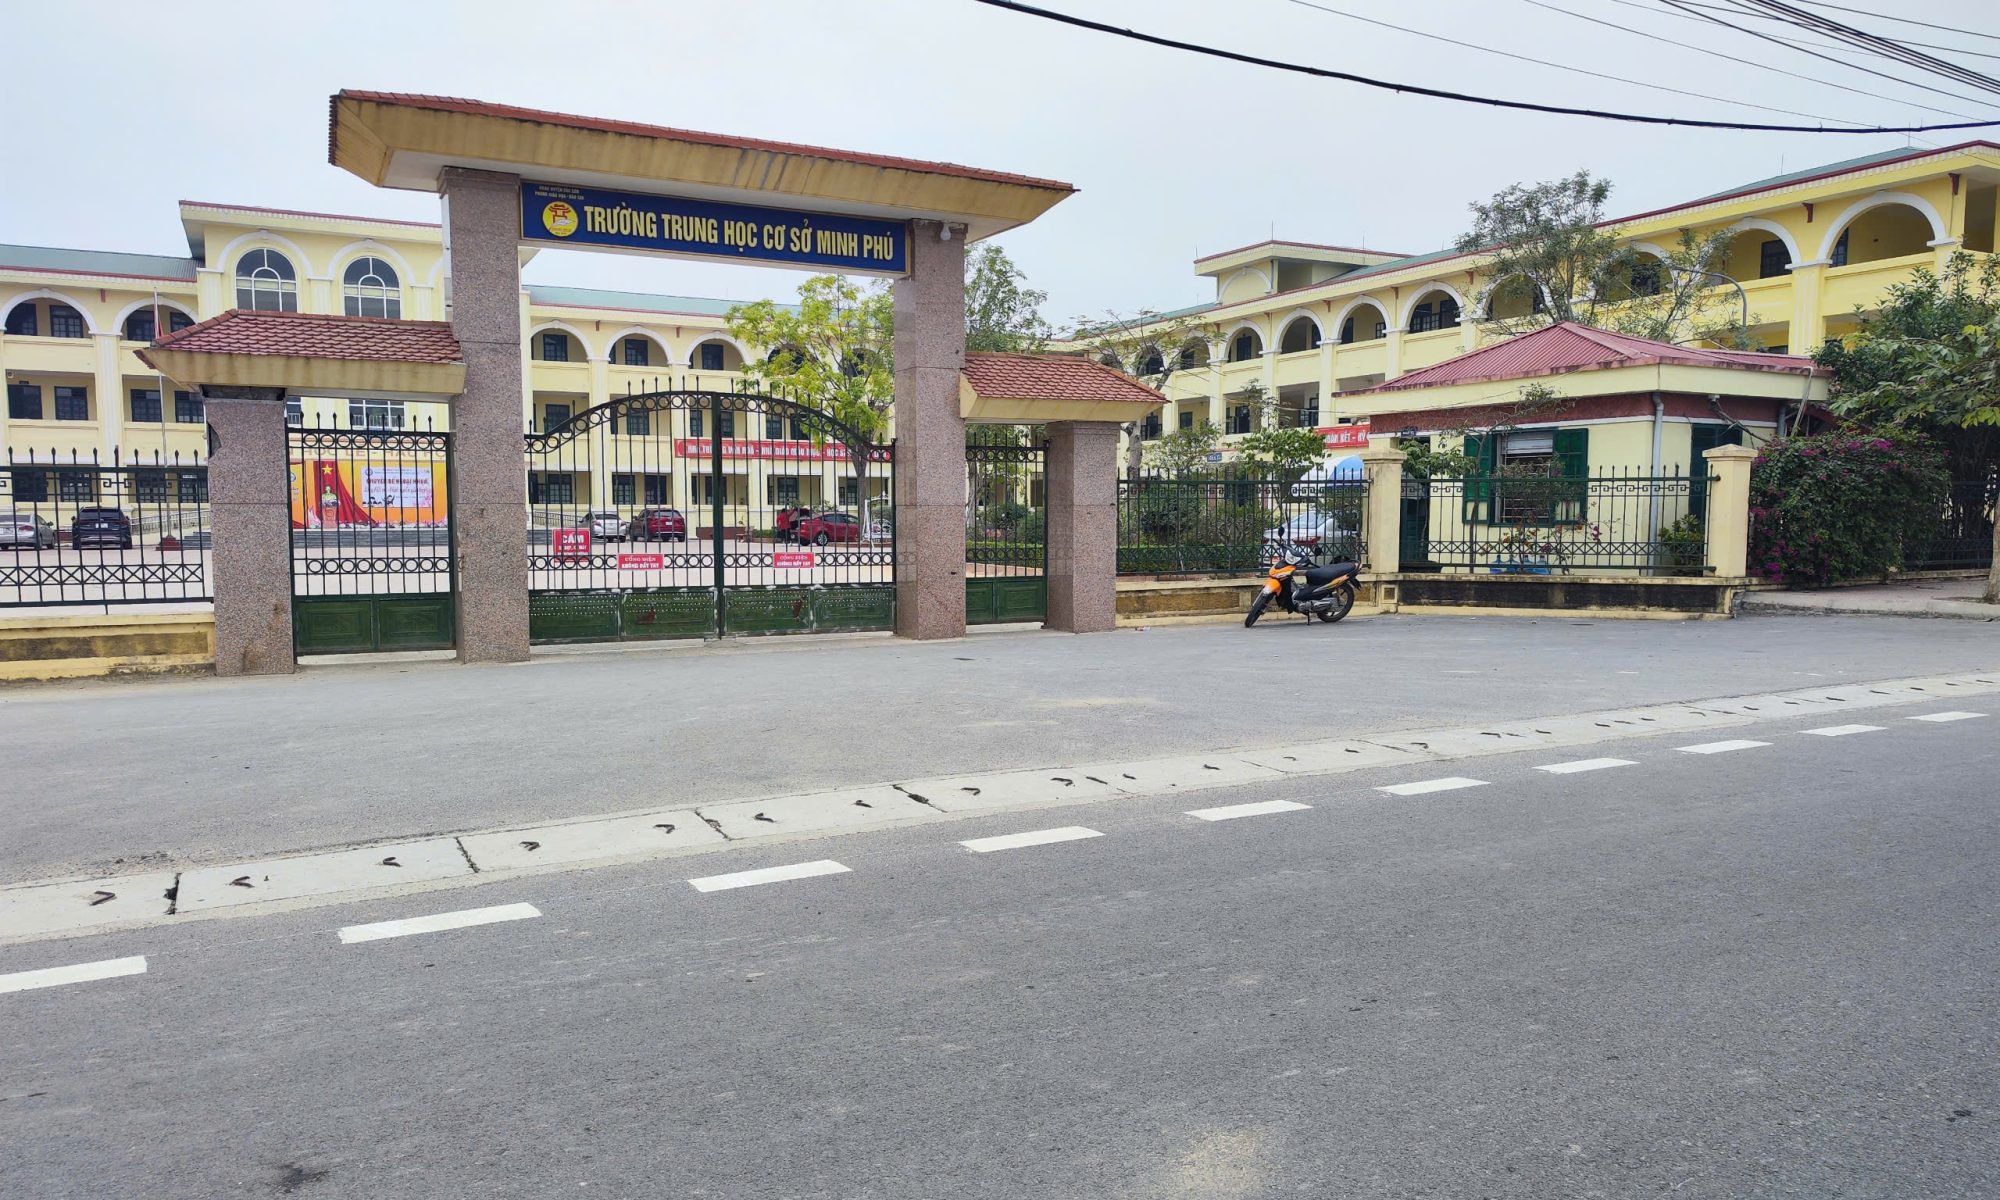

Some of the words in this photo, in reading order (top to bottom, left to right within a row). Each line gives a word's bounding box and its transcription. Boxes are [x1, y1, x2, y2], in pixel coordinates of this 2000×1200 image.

[584, 202, 657, 239] TRƯỜNG
[661, 213, 718, 244] TRUNG
[723, 220, 758, 252] HỌC
[763, 224, 786, 250] CƠ
[790, 218, 812, 254] SỞ
[817, 230, 858, 257] MINH
[863, 231, 894, 261] PHÚ
[562, 532, 584, 544] CẤM
